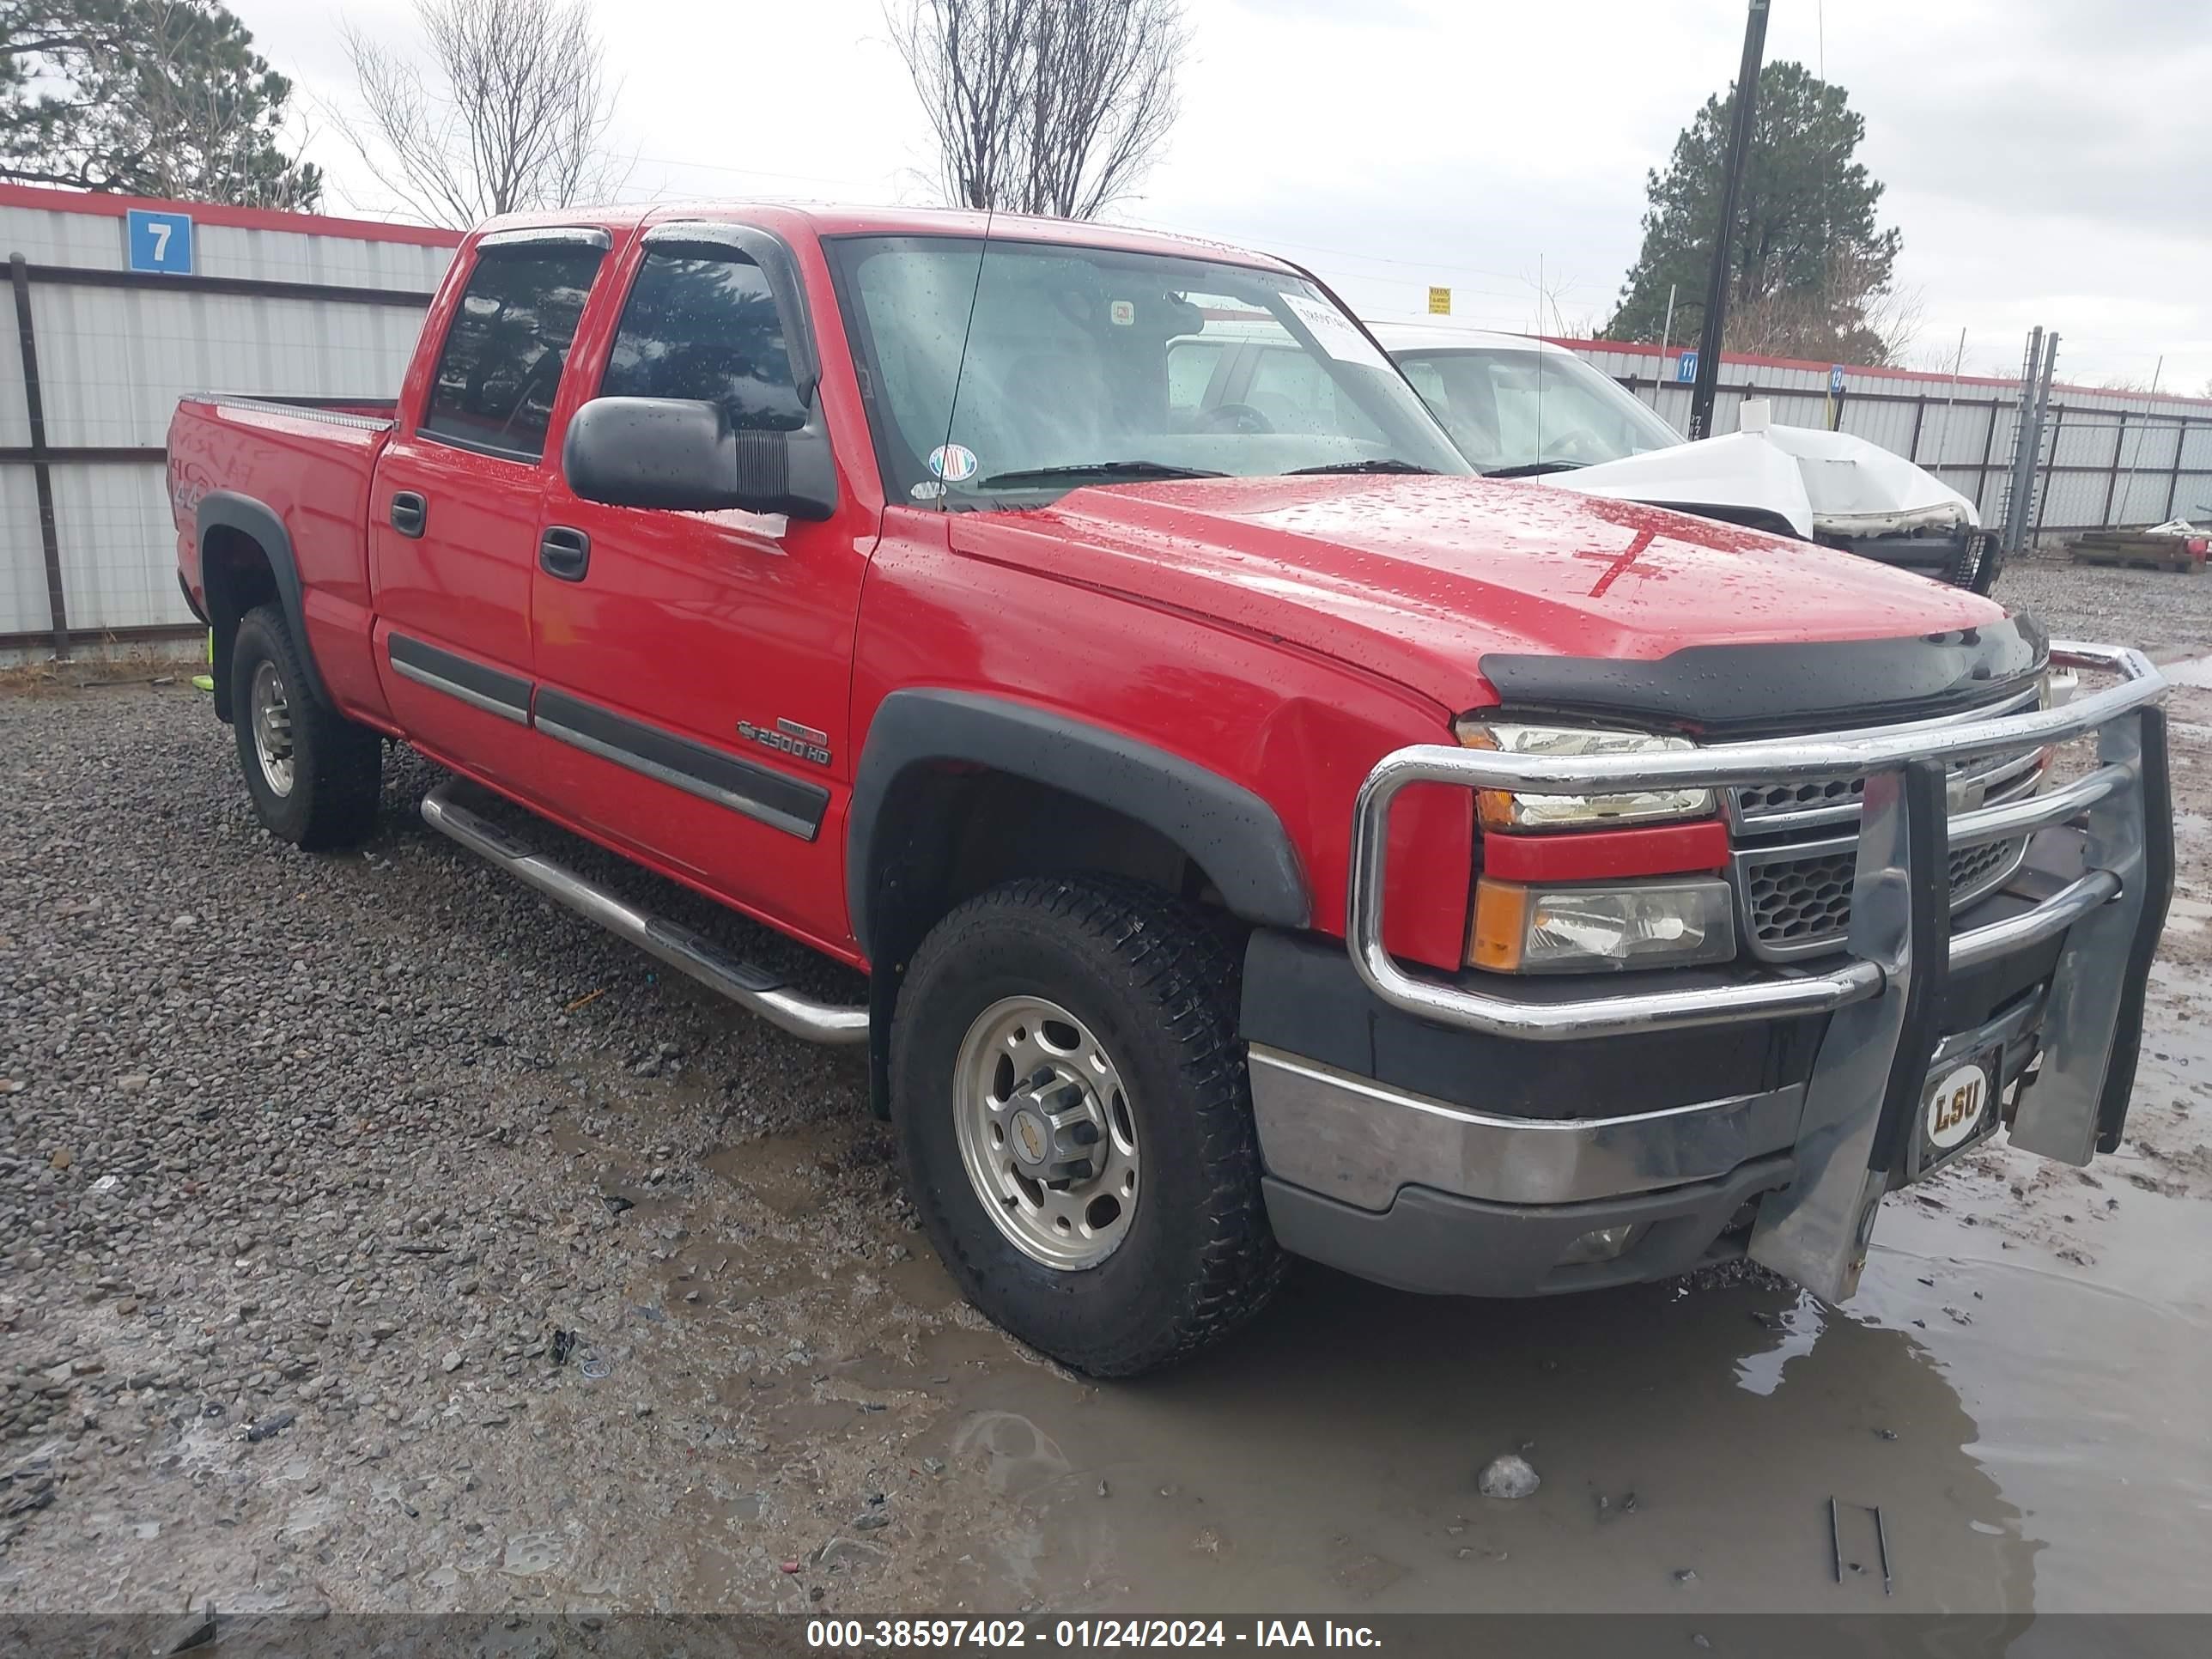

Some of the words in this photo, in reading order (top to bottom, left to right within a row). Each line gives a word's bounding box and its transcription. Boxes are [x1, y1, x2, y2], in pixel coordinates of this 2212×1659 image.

[148, 222, 172, 262] 7
[1683, 357, 1694, 377] 11
[1832, 370, 1842, 388] 12
[758, 727, 805, 757] 2500
[807, 746, 829, 764] HD
[1933, 1079, 1981, 1136] LSU
